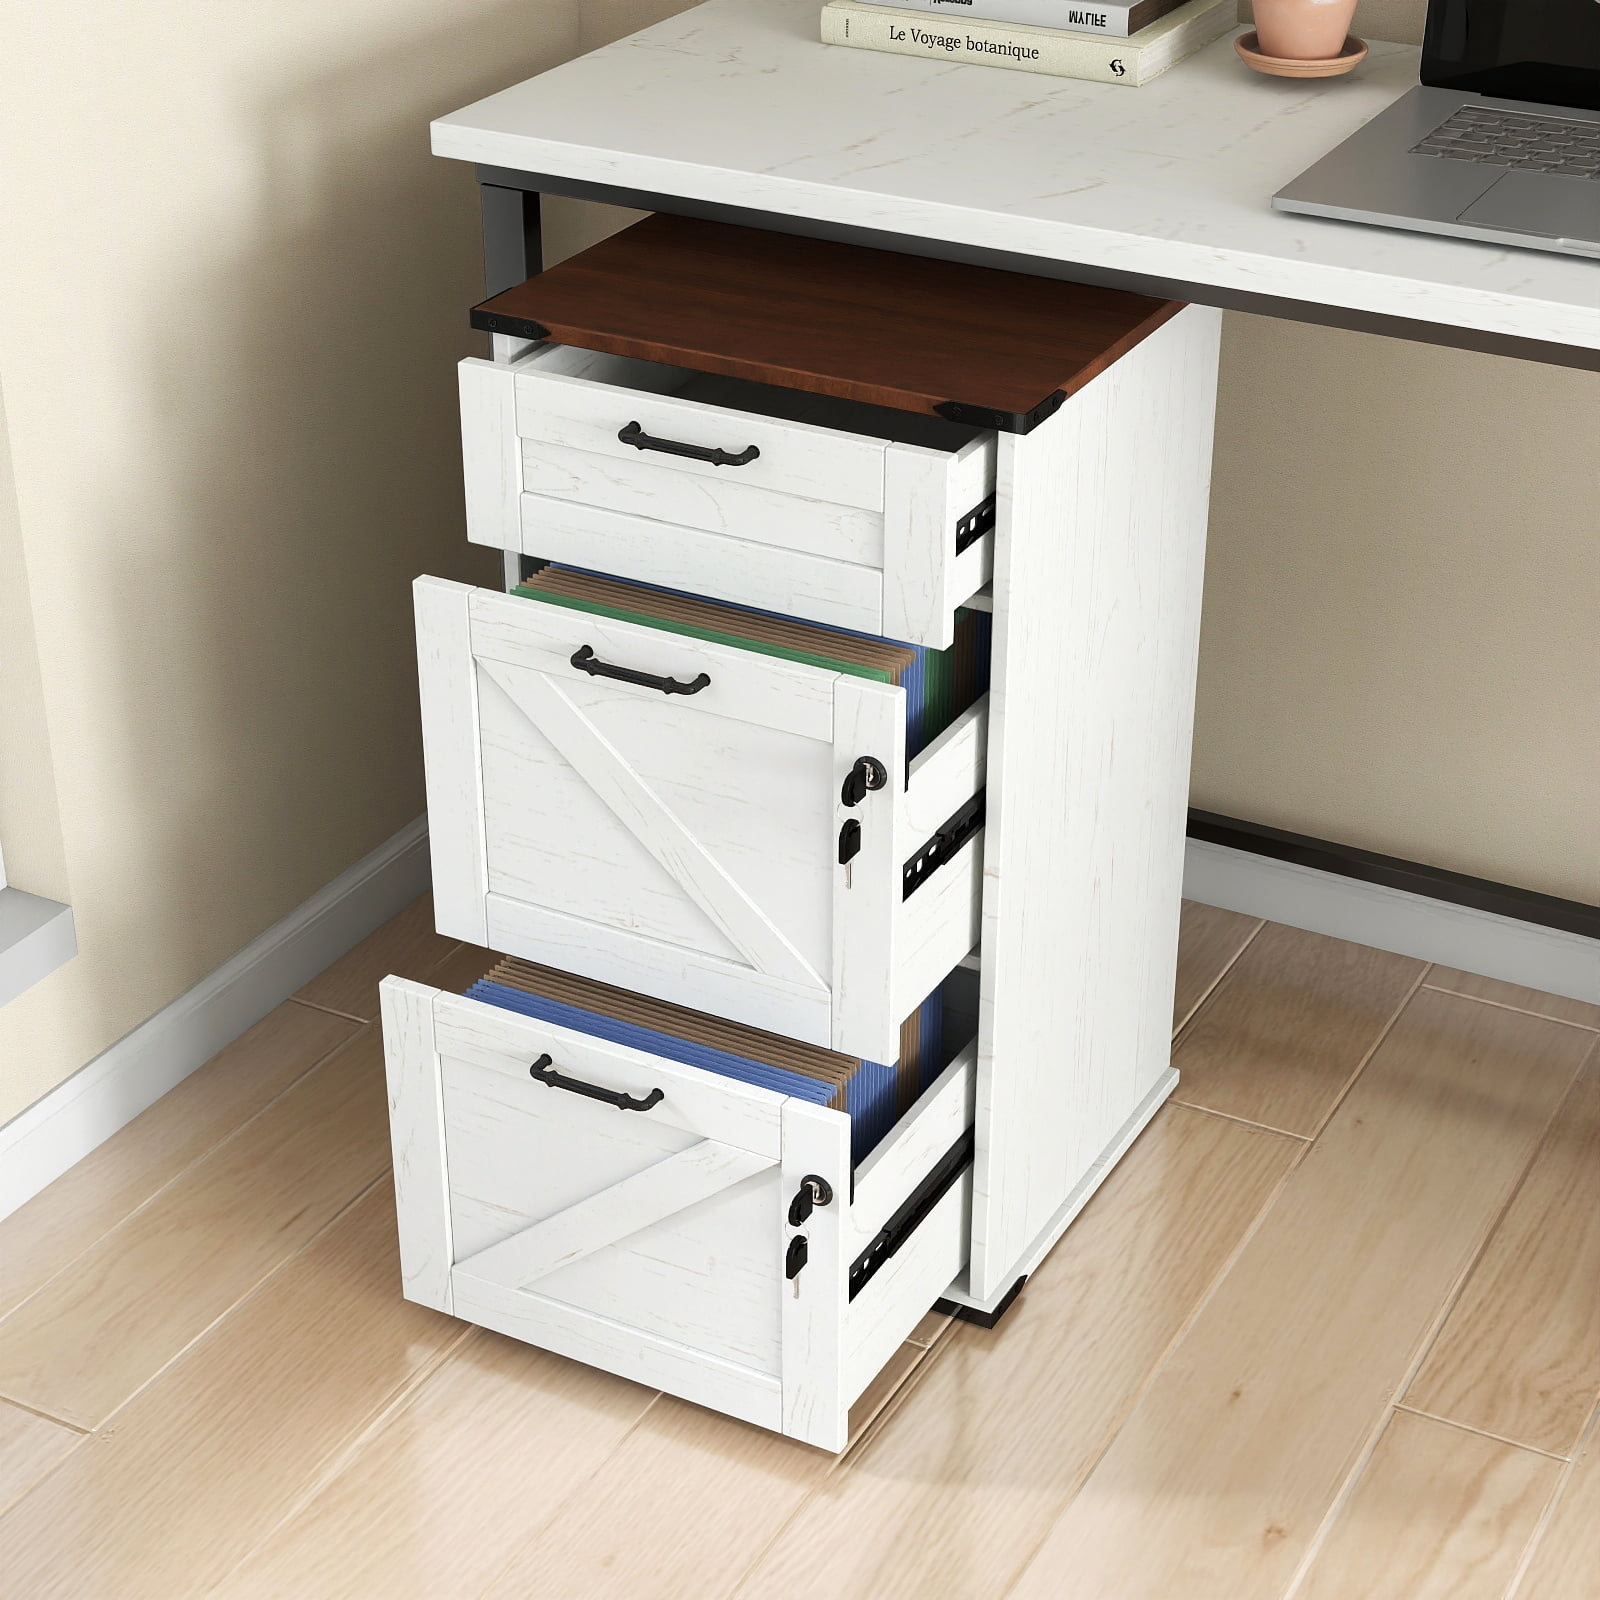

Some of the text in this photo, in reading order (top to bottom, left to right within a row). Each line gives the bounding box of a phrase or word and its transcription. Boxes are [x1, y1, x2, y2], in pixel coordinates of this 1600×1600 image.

[889, 25, 1040, 61] Le Voyage botanique
